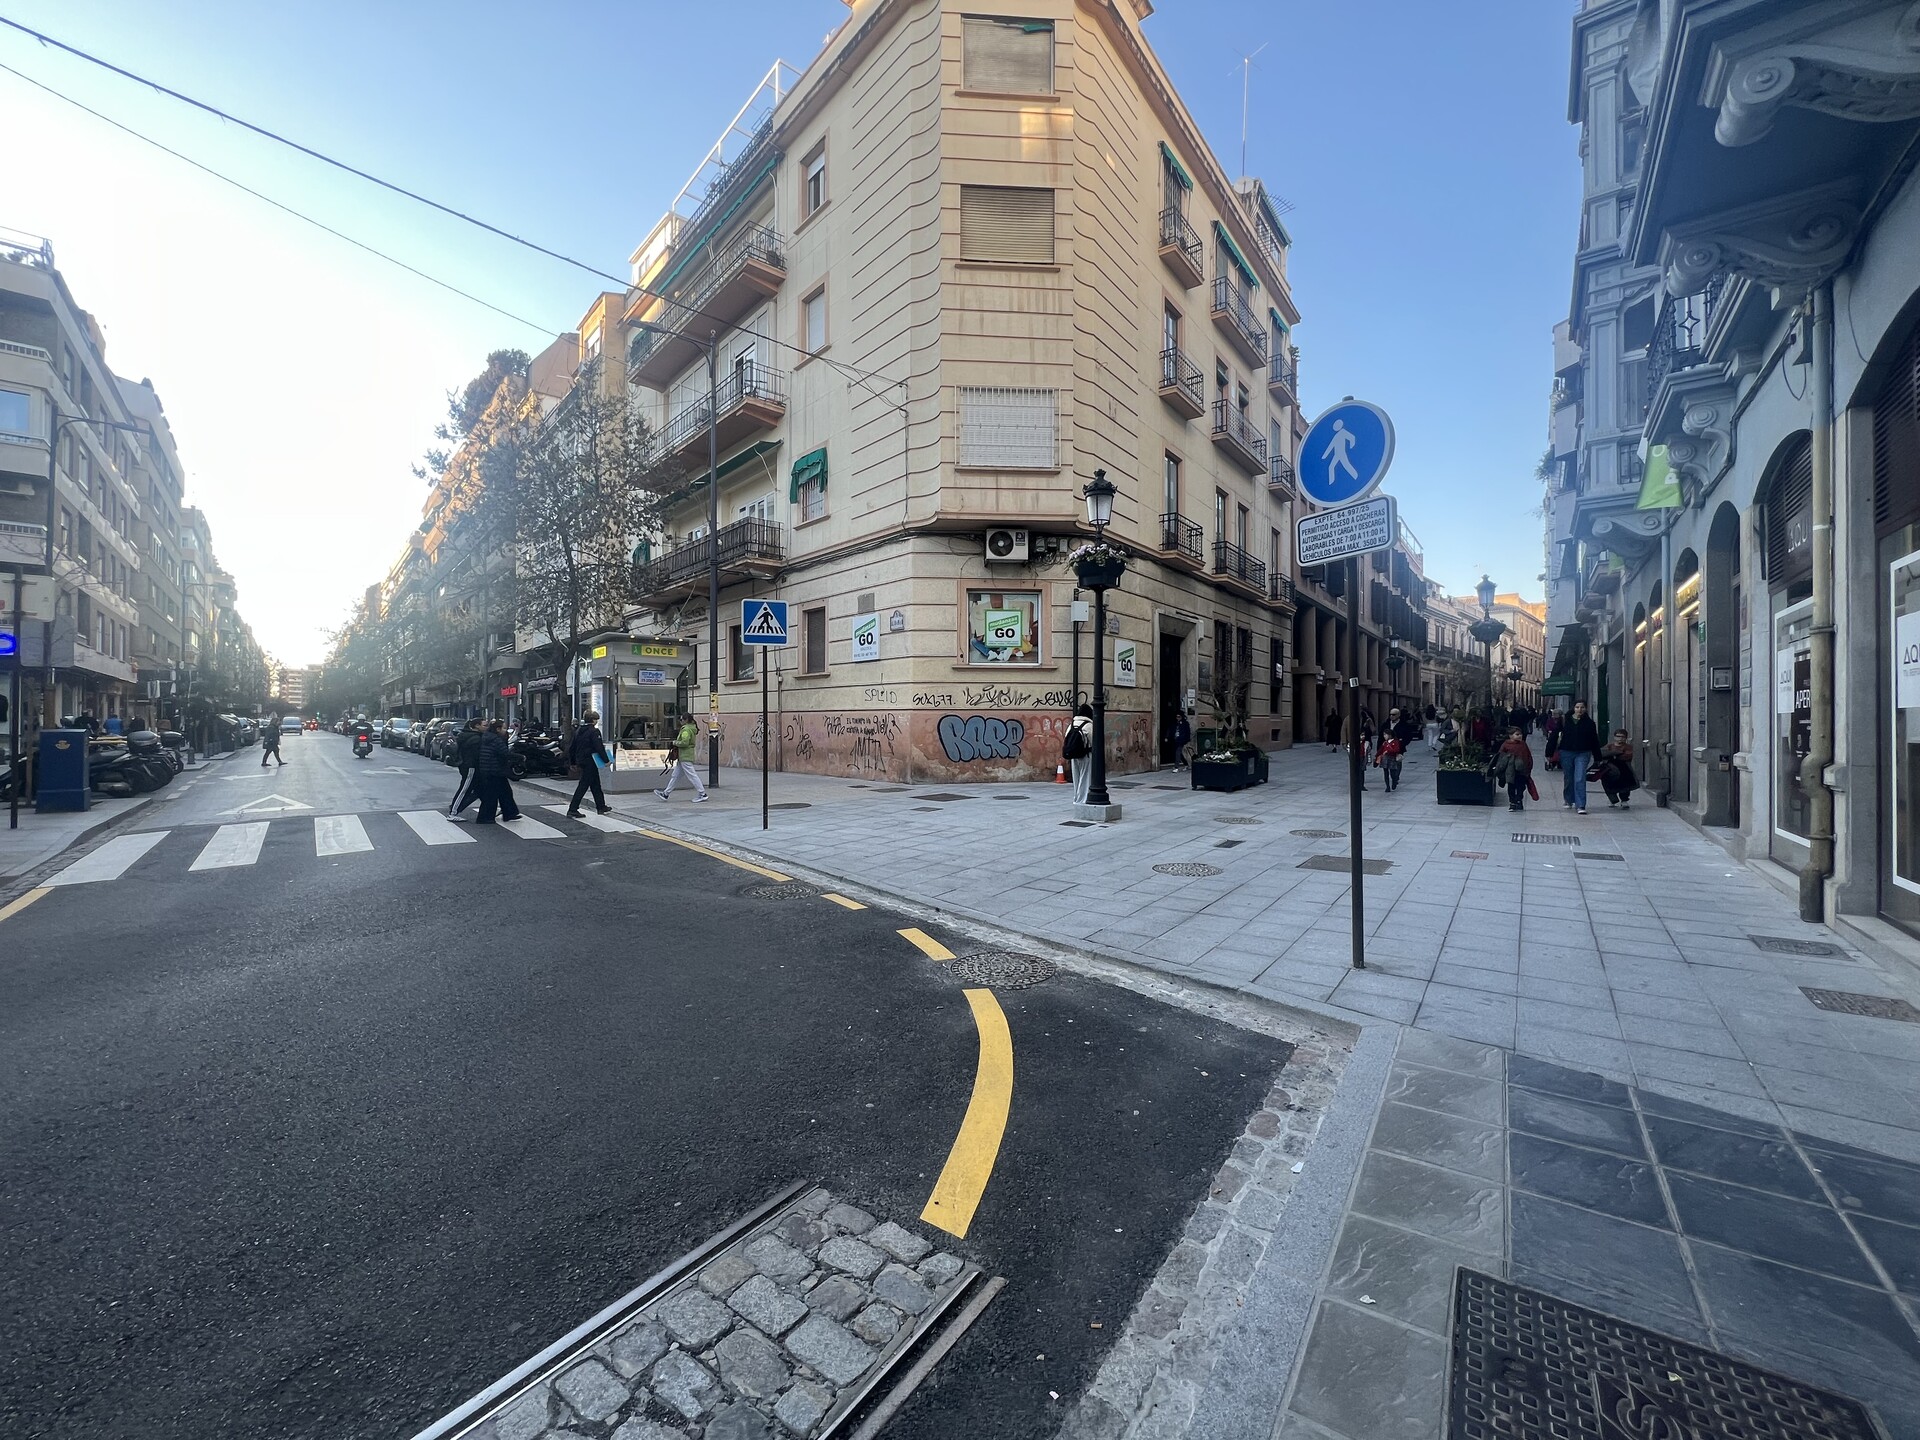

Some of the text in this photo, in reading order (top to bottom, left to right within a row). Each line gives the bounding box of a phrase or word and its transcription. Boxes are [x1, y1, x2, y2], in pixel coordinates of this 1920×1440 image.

[1301, 508, 1385, 537] PERMITIDO ACCESO A COCHERAS
[1314, 515, 1336, 525] EXPTE.
[1302, 530, 1333, 545] AUTORIZADAS
[1337, 525, 1354, 536] CARGA
[1359, 518, 1386, 531] DESCARGA
[1302, 539, 1335, 553] LABORABLES
[1336, 537, 1344, 545] DE
[1358, 532, 1362, 540] A
[1332, 544, 1346, 554] MMA
[1363, 538, 1377, 548] 3500
[994, 627, 1015, 638] GO
[645, 647, 673, 655] ONCE
[1903, 643, 1920, 665] AQ
